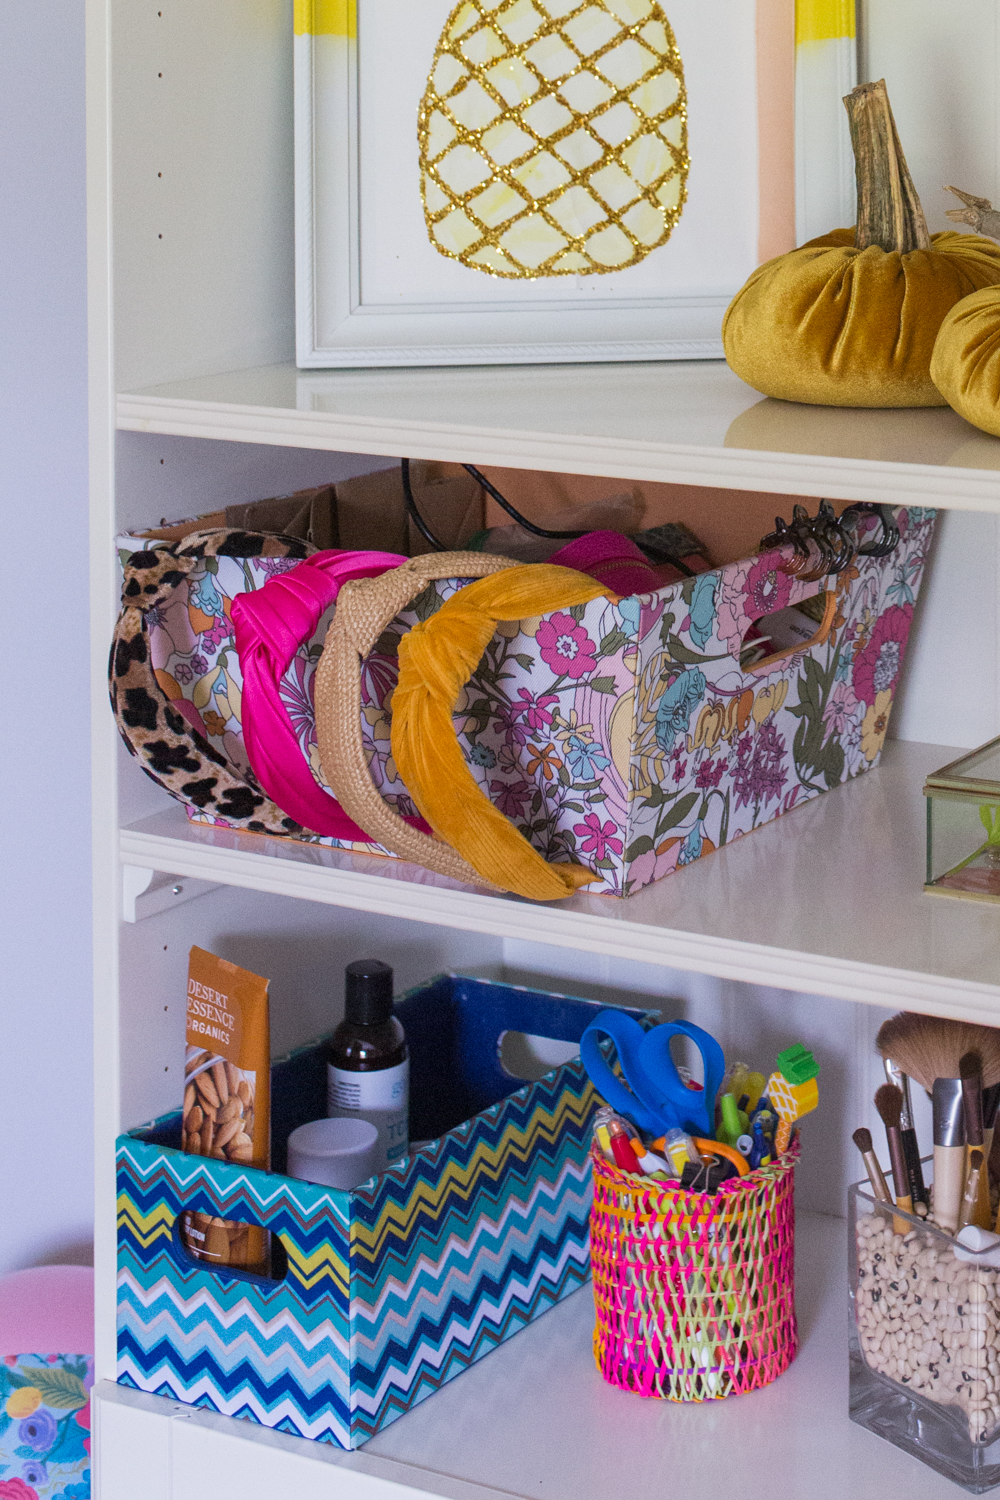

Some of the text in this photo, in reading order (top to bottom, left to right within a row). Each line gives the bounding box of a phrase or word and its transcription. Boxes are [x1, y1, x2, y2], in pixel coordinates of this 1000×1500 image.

[187, 978, 228, 1010] DESERT
[186, 996, 235, 1032] ESSENCE
[186, 1016, 230, 1045] ORGANICS
